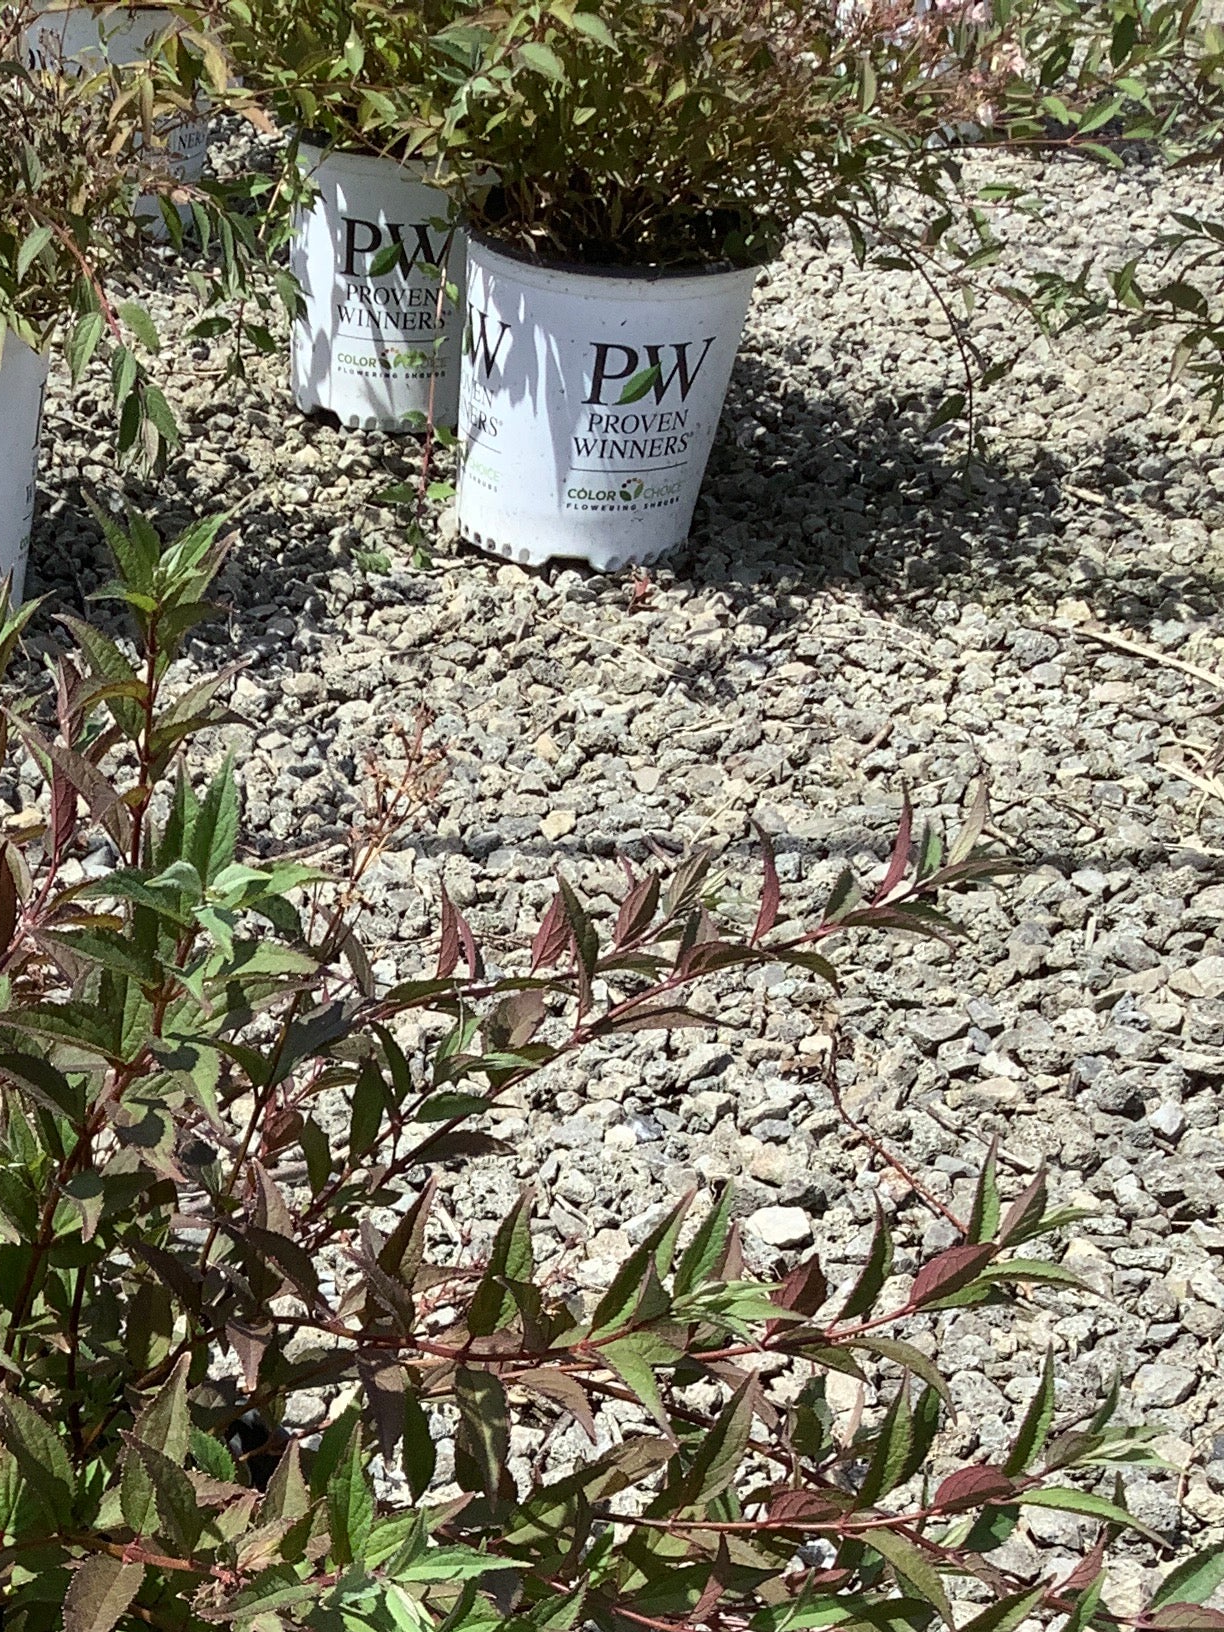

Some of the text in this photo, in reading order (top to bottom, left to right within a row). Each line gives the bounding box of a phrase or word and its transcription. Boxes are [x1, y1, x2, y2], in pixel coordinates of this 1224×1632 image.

[341, 217, 452, 281] PW
[337, 352, 376, 368] COLOR
[581, 336, 716, 406] PW
[588, 409, 689, 434] PROVEN
[567, 488, 616, 501] COLOR
[566, 502, 637, 511] FLOWERING
